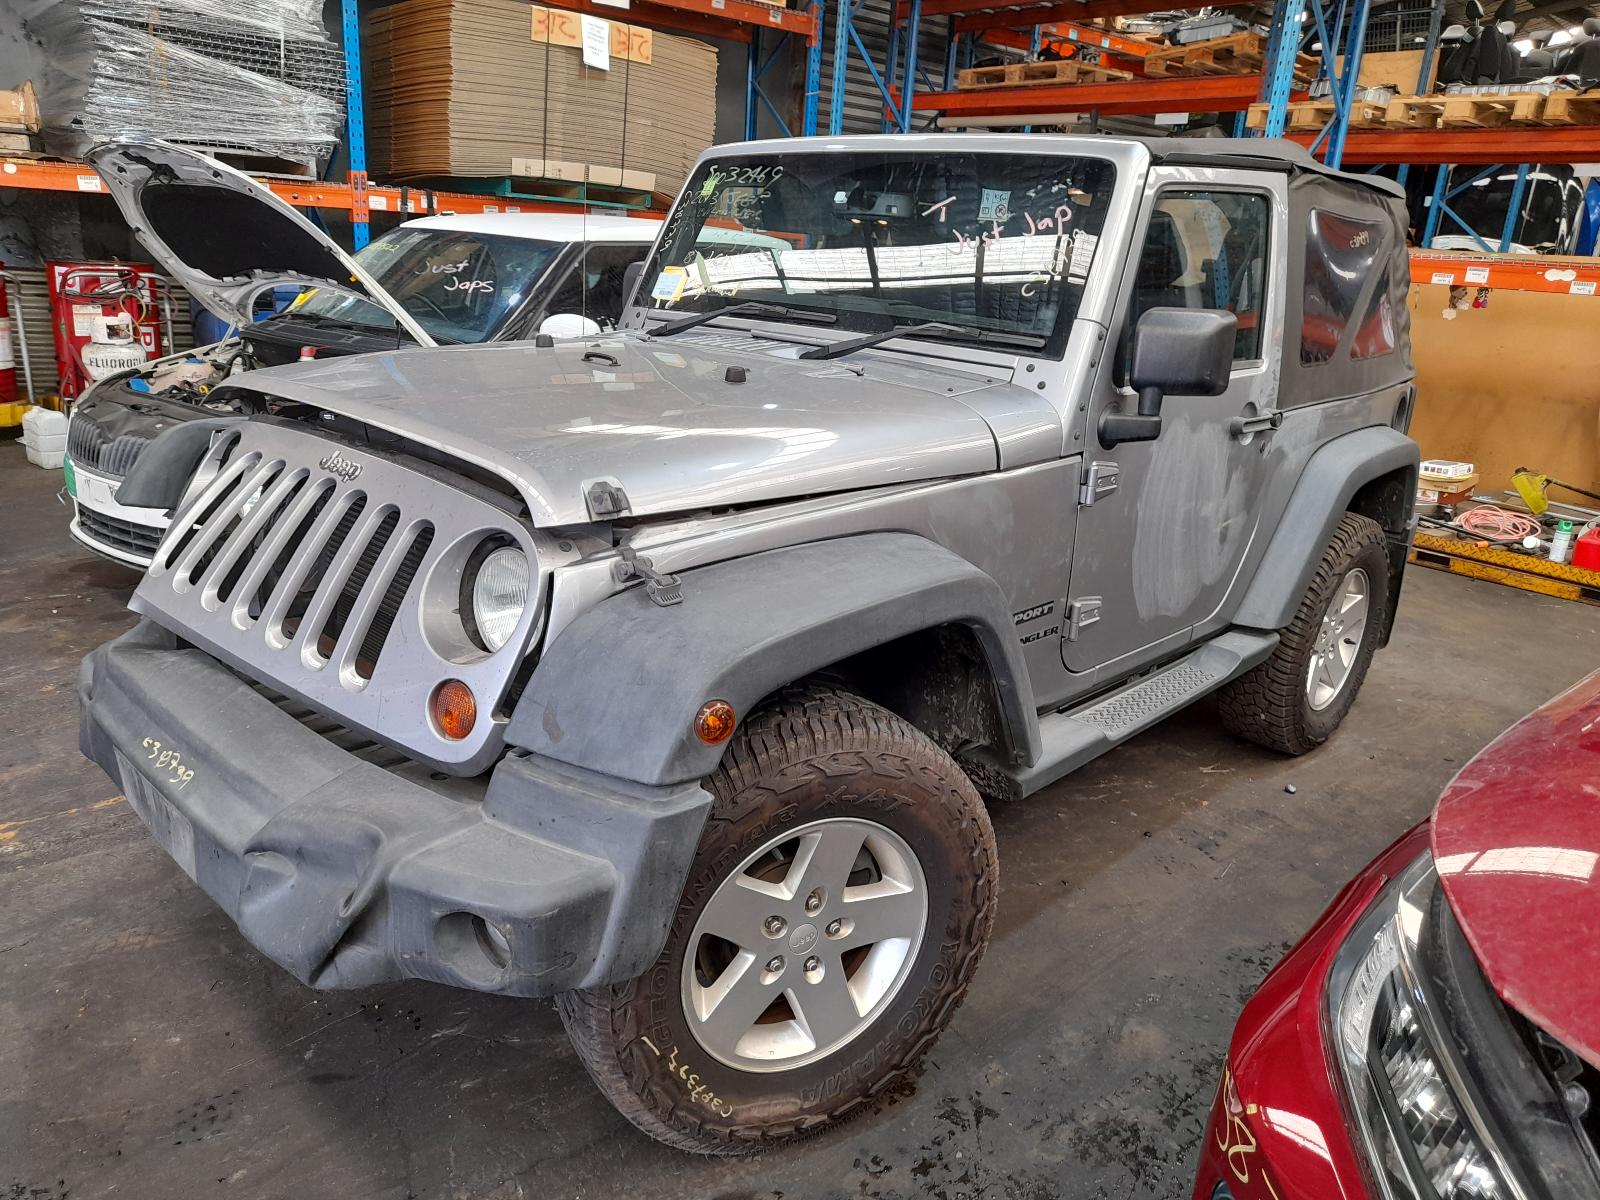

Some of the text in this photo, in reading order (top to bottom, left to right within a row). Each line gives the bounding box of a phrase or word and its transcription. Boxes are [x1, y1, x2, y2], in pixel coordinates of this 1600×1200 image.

[443, 276, 494, 295] Japs
[319, 450, 364, 484] Jeep
[1013, 602, 1055, 624] PORT
[1020, 625, 1059, 645] NGLER
